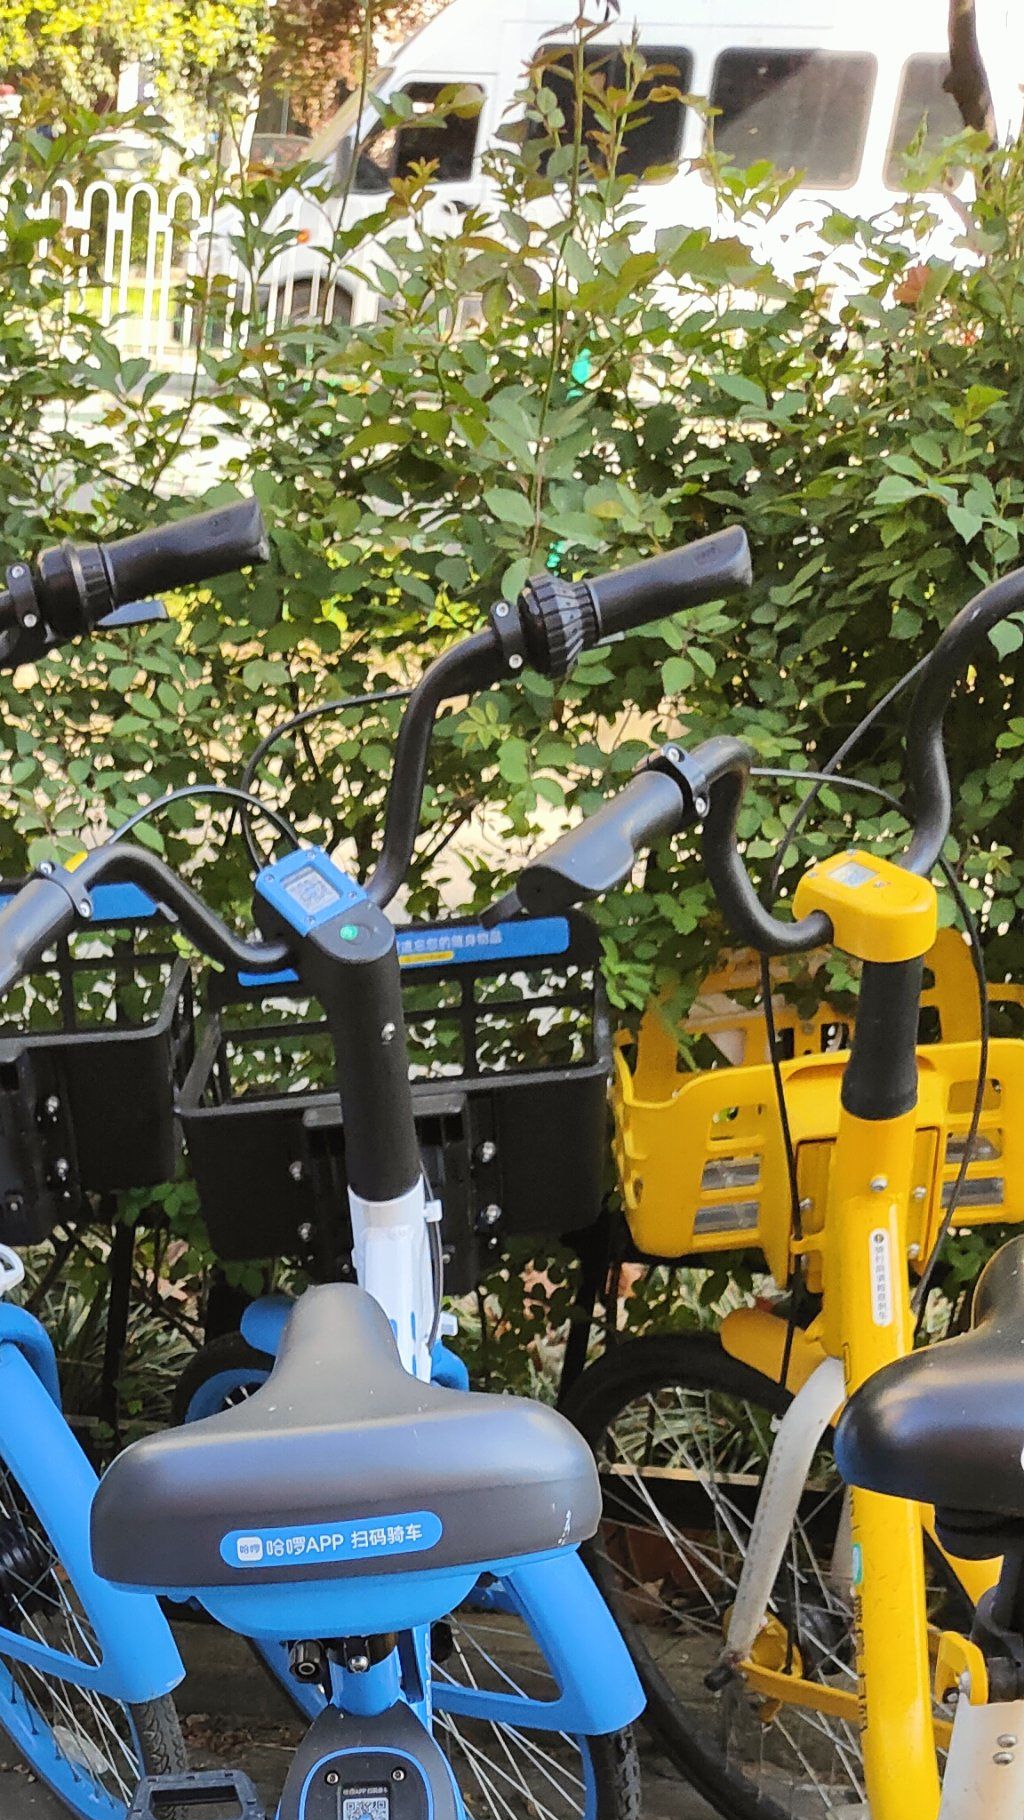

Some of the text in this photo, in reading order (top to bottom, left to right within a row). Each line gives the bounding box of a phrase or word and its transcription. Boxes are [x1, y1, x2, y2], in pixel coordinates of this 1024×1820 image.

[266, 1523, 422, 1556] 哈啰APP 扫码骑车
